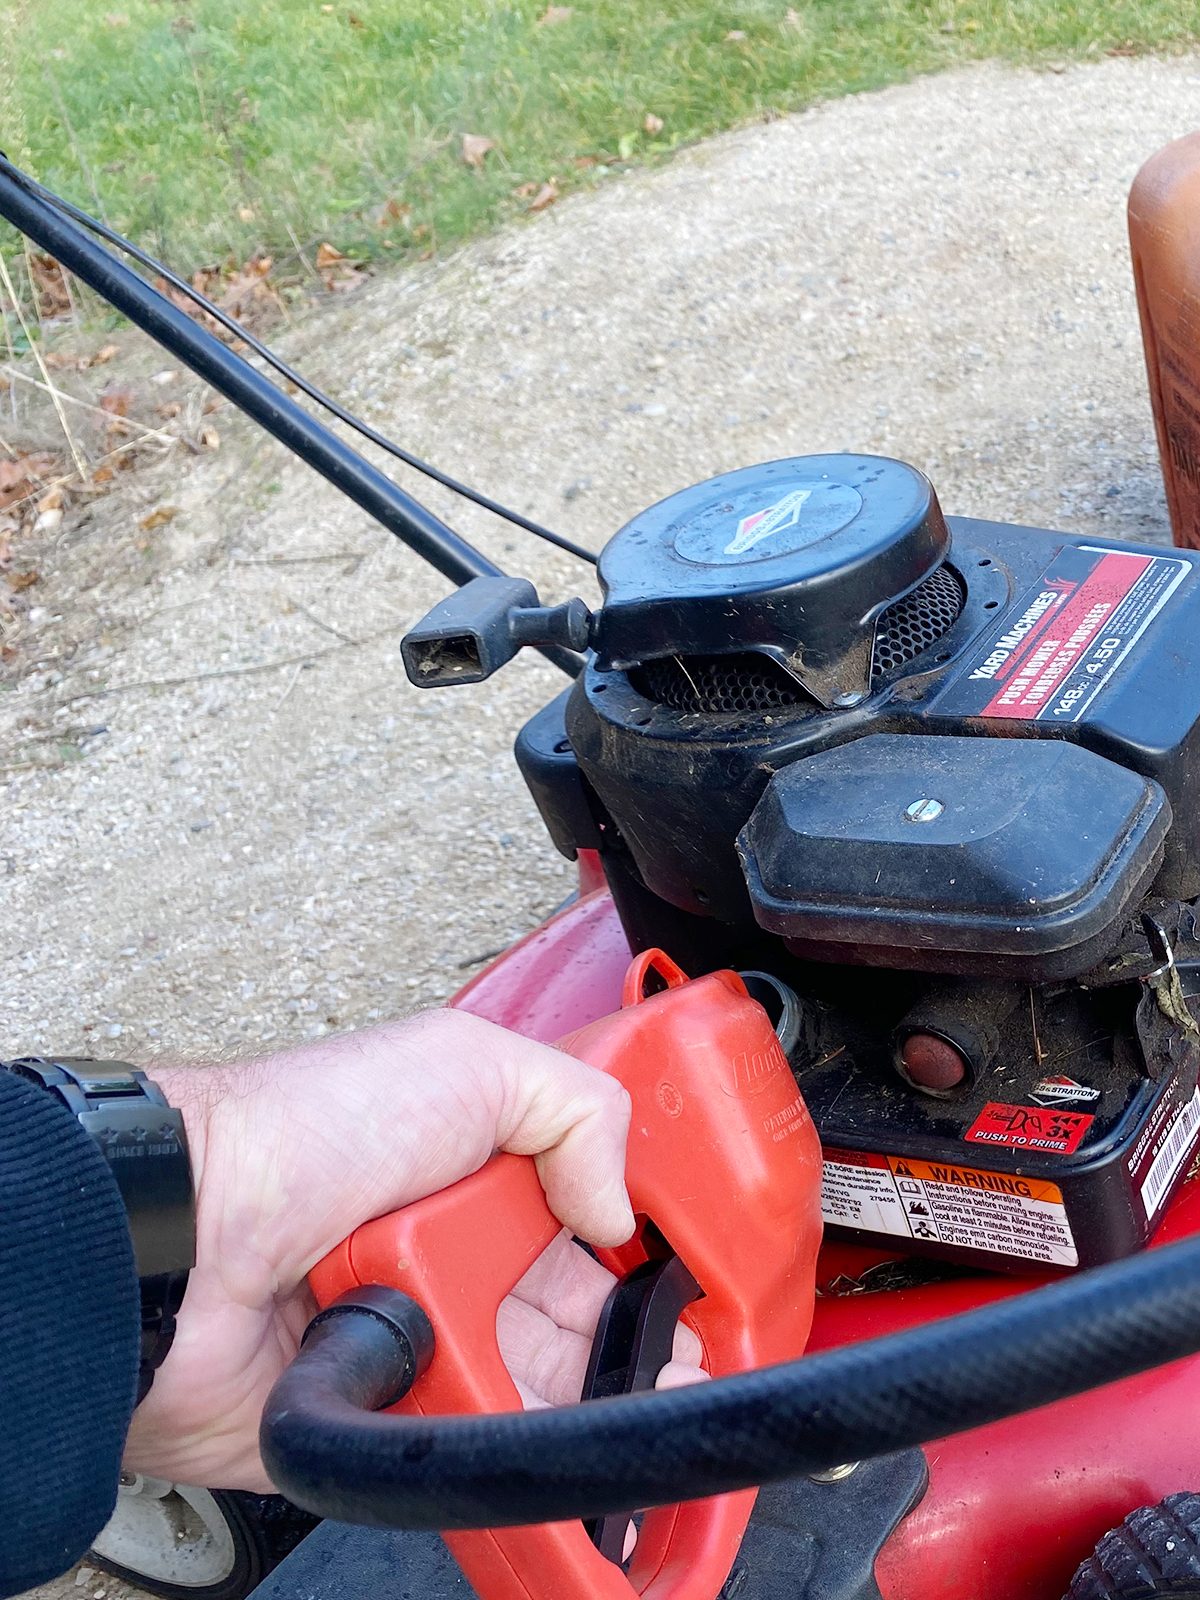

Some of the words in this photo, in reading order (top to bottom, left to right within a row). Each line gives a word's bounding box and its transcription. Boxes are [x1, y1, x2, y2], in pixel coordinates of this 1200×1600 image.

[968, 648, 1010, 680] YARD
[995, 591, 1058, 649] MACHINES
[1020, 650, 1076, 705] TONDEUSES
[1064, 602, 1111, 648] POUSSÉES
[1086, 638, 1121, 673] 4.50
[997, 678, 1032, 705] PUSH
[1019, 640, 1061, 677] MOWER
[975, 1131, 1008, 1142] PUSH
[1012, 1135, 1027, 1144] TO
[1029, 1138, 1068, 1150] PRIME
[837, 1174, 881, 1185] maintenance
[855, 1169, 887, 1178] emission
[928, 1165, 1032, 1197] WARNING
[847, 1183, 879, 1193] durability
[925, 1182, 944, 1191] Read
[946, 1186, 960, 1194] and
[960, 1187, 983, 1197] follow
[984, 1191, 1022, 1207] Operating
[932, 1202, 963, 1213] Gasoline
[964, 1207, 971, 1215] is
[972, 1209, 1010, 1222] flammable.
[1011, 1216, 1030, 1227] Allow
[1031, 1222, 1056, 1233] engine
[1056, 1226, 1065, 1234] to
[973, 1198, 996, 1209] before
[998, 1204, 1028, 1217] running
[1028, 1210, 1056, 1222] engine.
[934, 1212, 950, 1221] cool
[960, 1215, 977, 1225] least
[984, 1220, 1012, 1232] minutes
[1012, 1226, 1036, 1237] before
[939, 1223, 969, 1235] Engines
[970, 1229, 986, 1238] emit
[987, 1232, 1013, 1243] carbon
[942, 1234, 953, 1242] DO
[955, 1236, 972, 1245] NOT
[974, 1240, 987, 1248] run
[989, 1241, 996, 1249] in
[998, 1245, 1033, 1257] enclosed
[1034, 1251, 1053, 1261] area.
